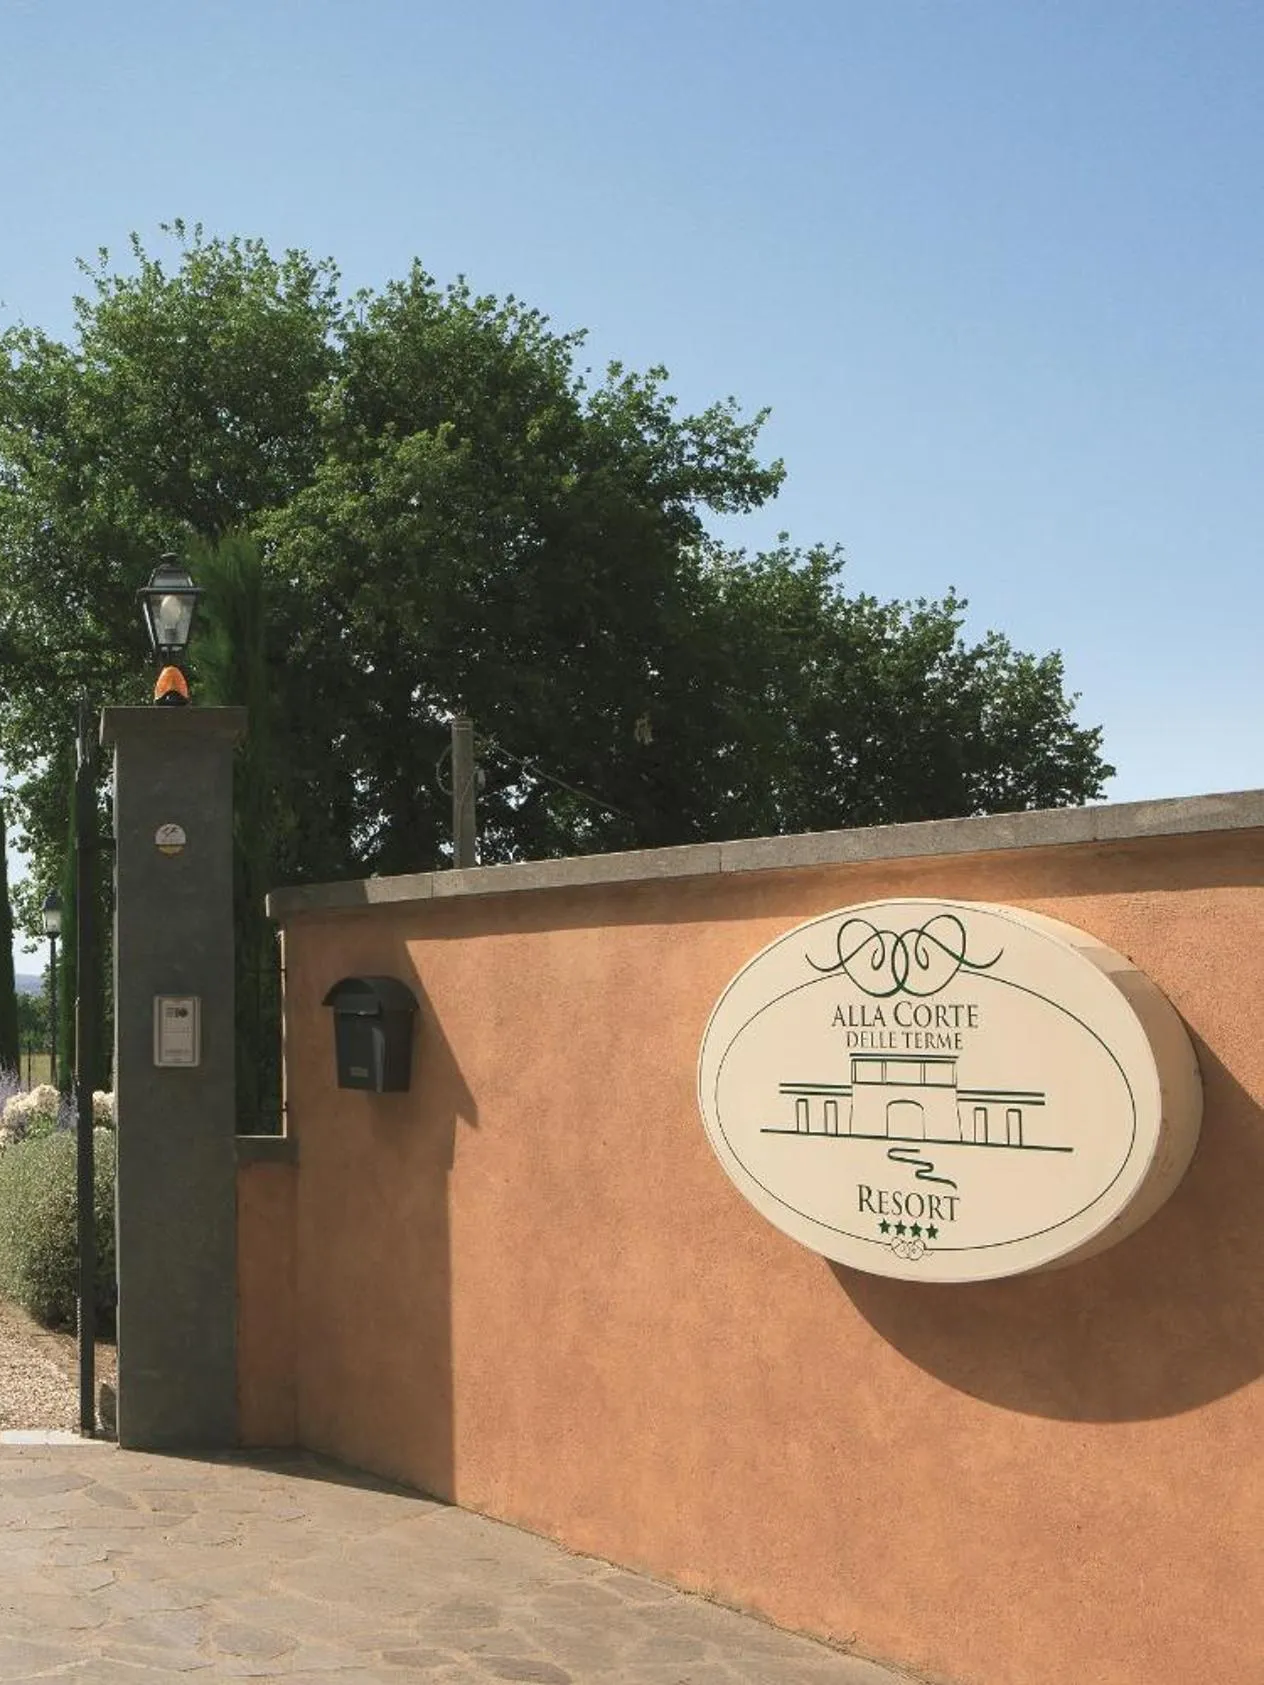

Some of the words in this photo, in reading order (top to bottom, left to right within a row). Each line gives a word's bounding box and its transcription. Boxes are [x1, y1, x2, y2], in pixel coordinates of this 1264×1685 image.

[832, 1003, 886, 1027] ALLA
[893, 1001, 979, 1028] CORTE
[846, 1031, 897, 1049] DELLE
[901, 1032, 963, 1050] TERME
[857, 1184, 960, 1221] RESORT
